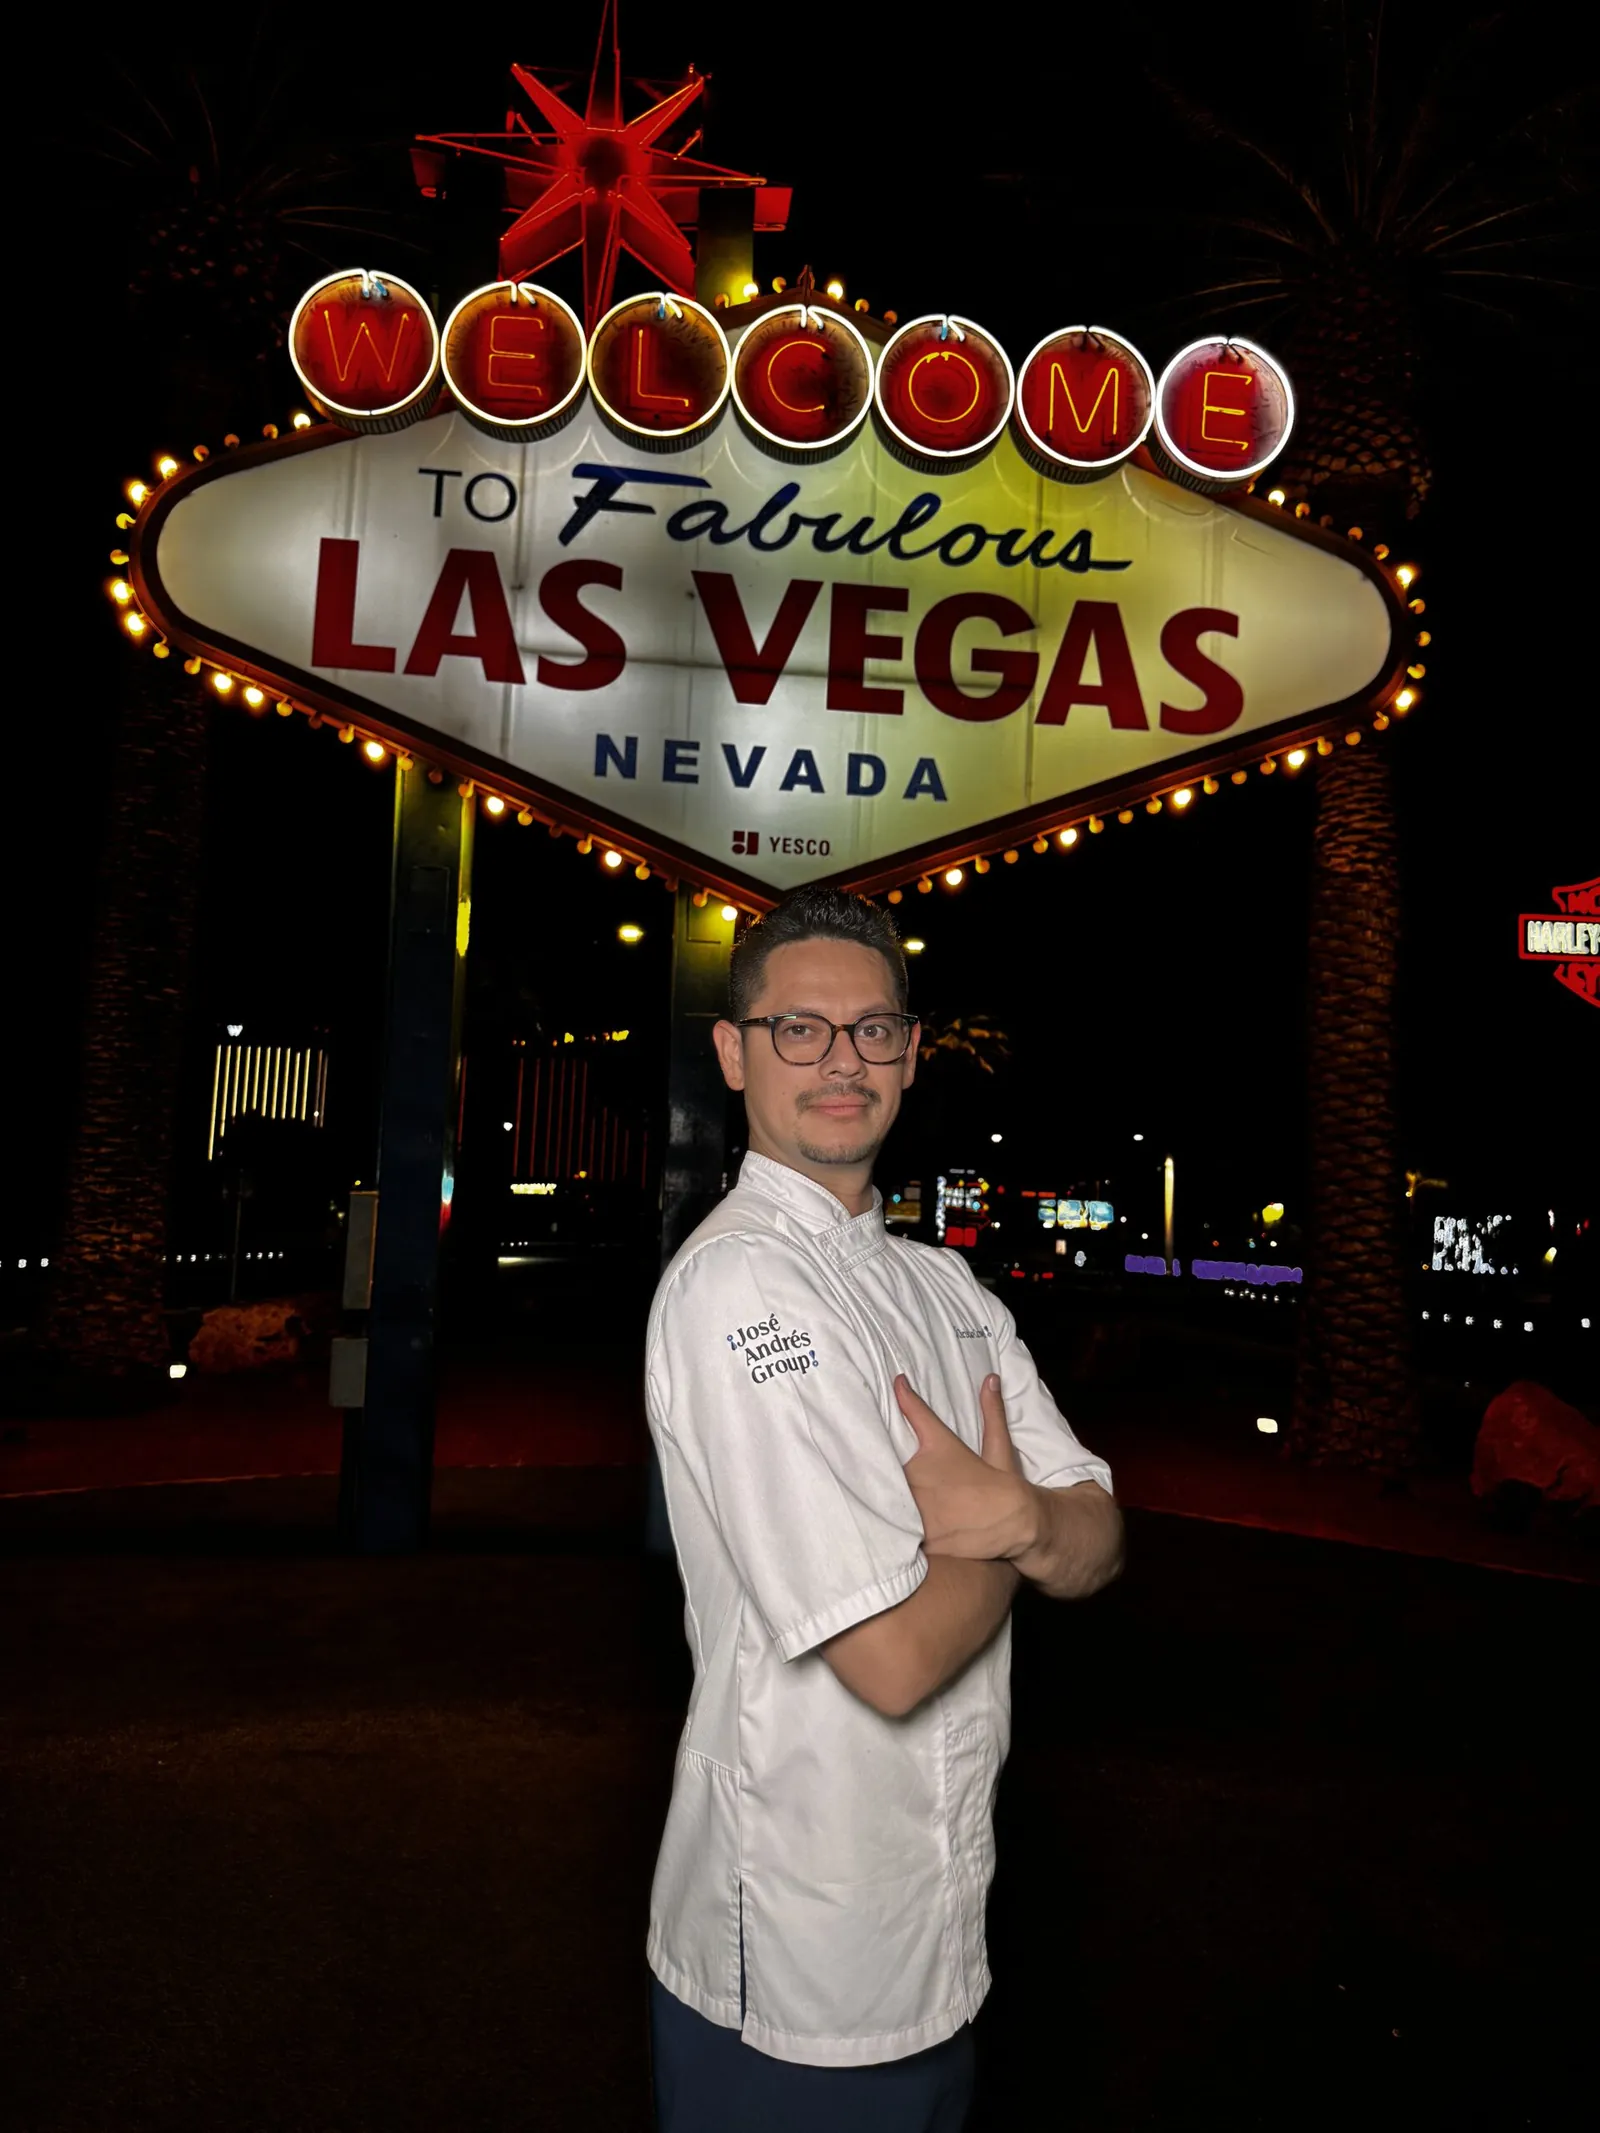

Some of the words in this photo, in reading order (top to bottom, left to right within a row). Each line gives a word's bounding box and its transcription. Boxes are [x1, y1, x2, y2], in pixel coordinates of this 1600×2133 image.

[312, 298, 1260, 455] WELCOME
[418, 467, 517, 522] TO
[558, 462, 1133, 573] Fabulous
[311, 537, 627, 691] LAS
[691, 570, 1245, 736] VEGAS
[593, 733, 948, 802] NEVADA
[769, 836, 830, 857] YESCO
[744, 1329, 812, 1367] Andrés
